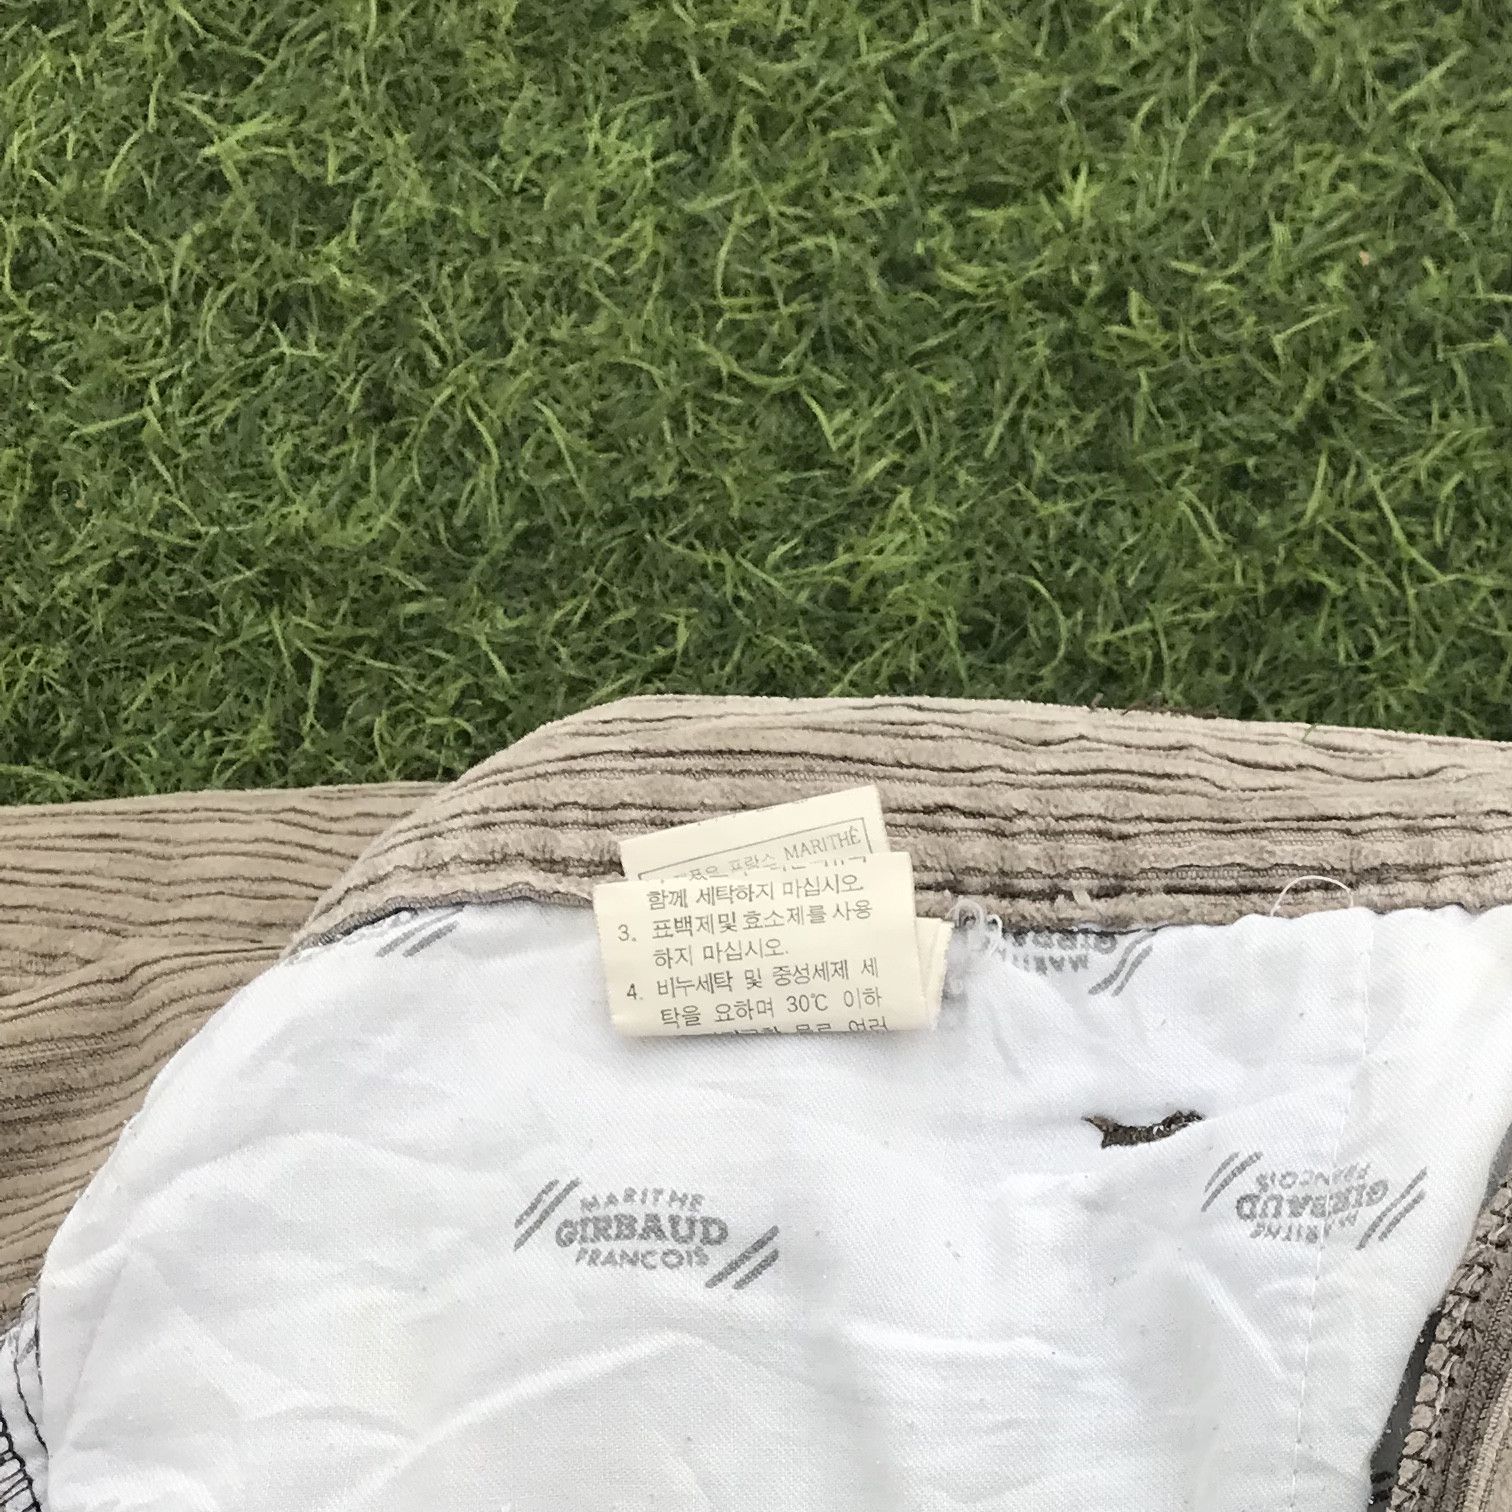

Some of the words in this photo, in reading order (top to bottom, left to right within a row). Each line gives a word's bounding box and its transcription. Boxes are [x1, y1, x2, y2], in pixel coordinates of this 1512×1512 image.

[647, 888, 689, 911] 함께
[696, 880, 775, 907] 세탁하지
[617, 923, 637, 942] 3.
[652, 943, 694, 970] 하지
[702, 937, 789, 964] 마십시오.
[626, 982, 644, 1000] 4.
[656, 969, 733, 998] 비누세탁
[744, 967, 763, 990] 및
[772, 959, 850, 986] 중성세제
[860, 956, 879, 979] 세
[660, 1004, 702, 1029] 탁을
[714, 997, 775, 1023] 요하며
[843, 985, 882, 1010] 이하
[1235, 1178, 1389, 1222] GIRBAUD
[555, 1213, 729, 1248] GIRBAUD
